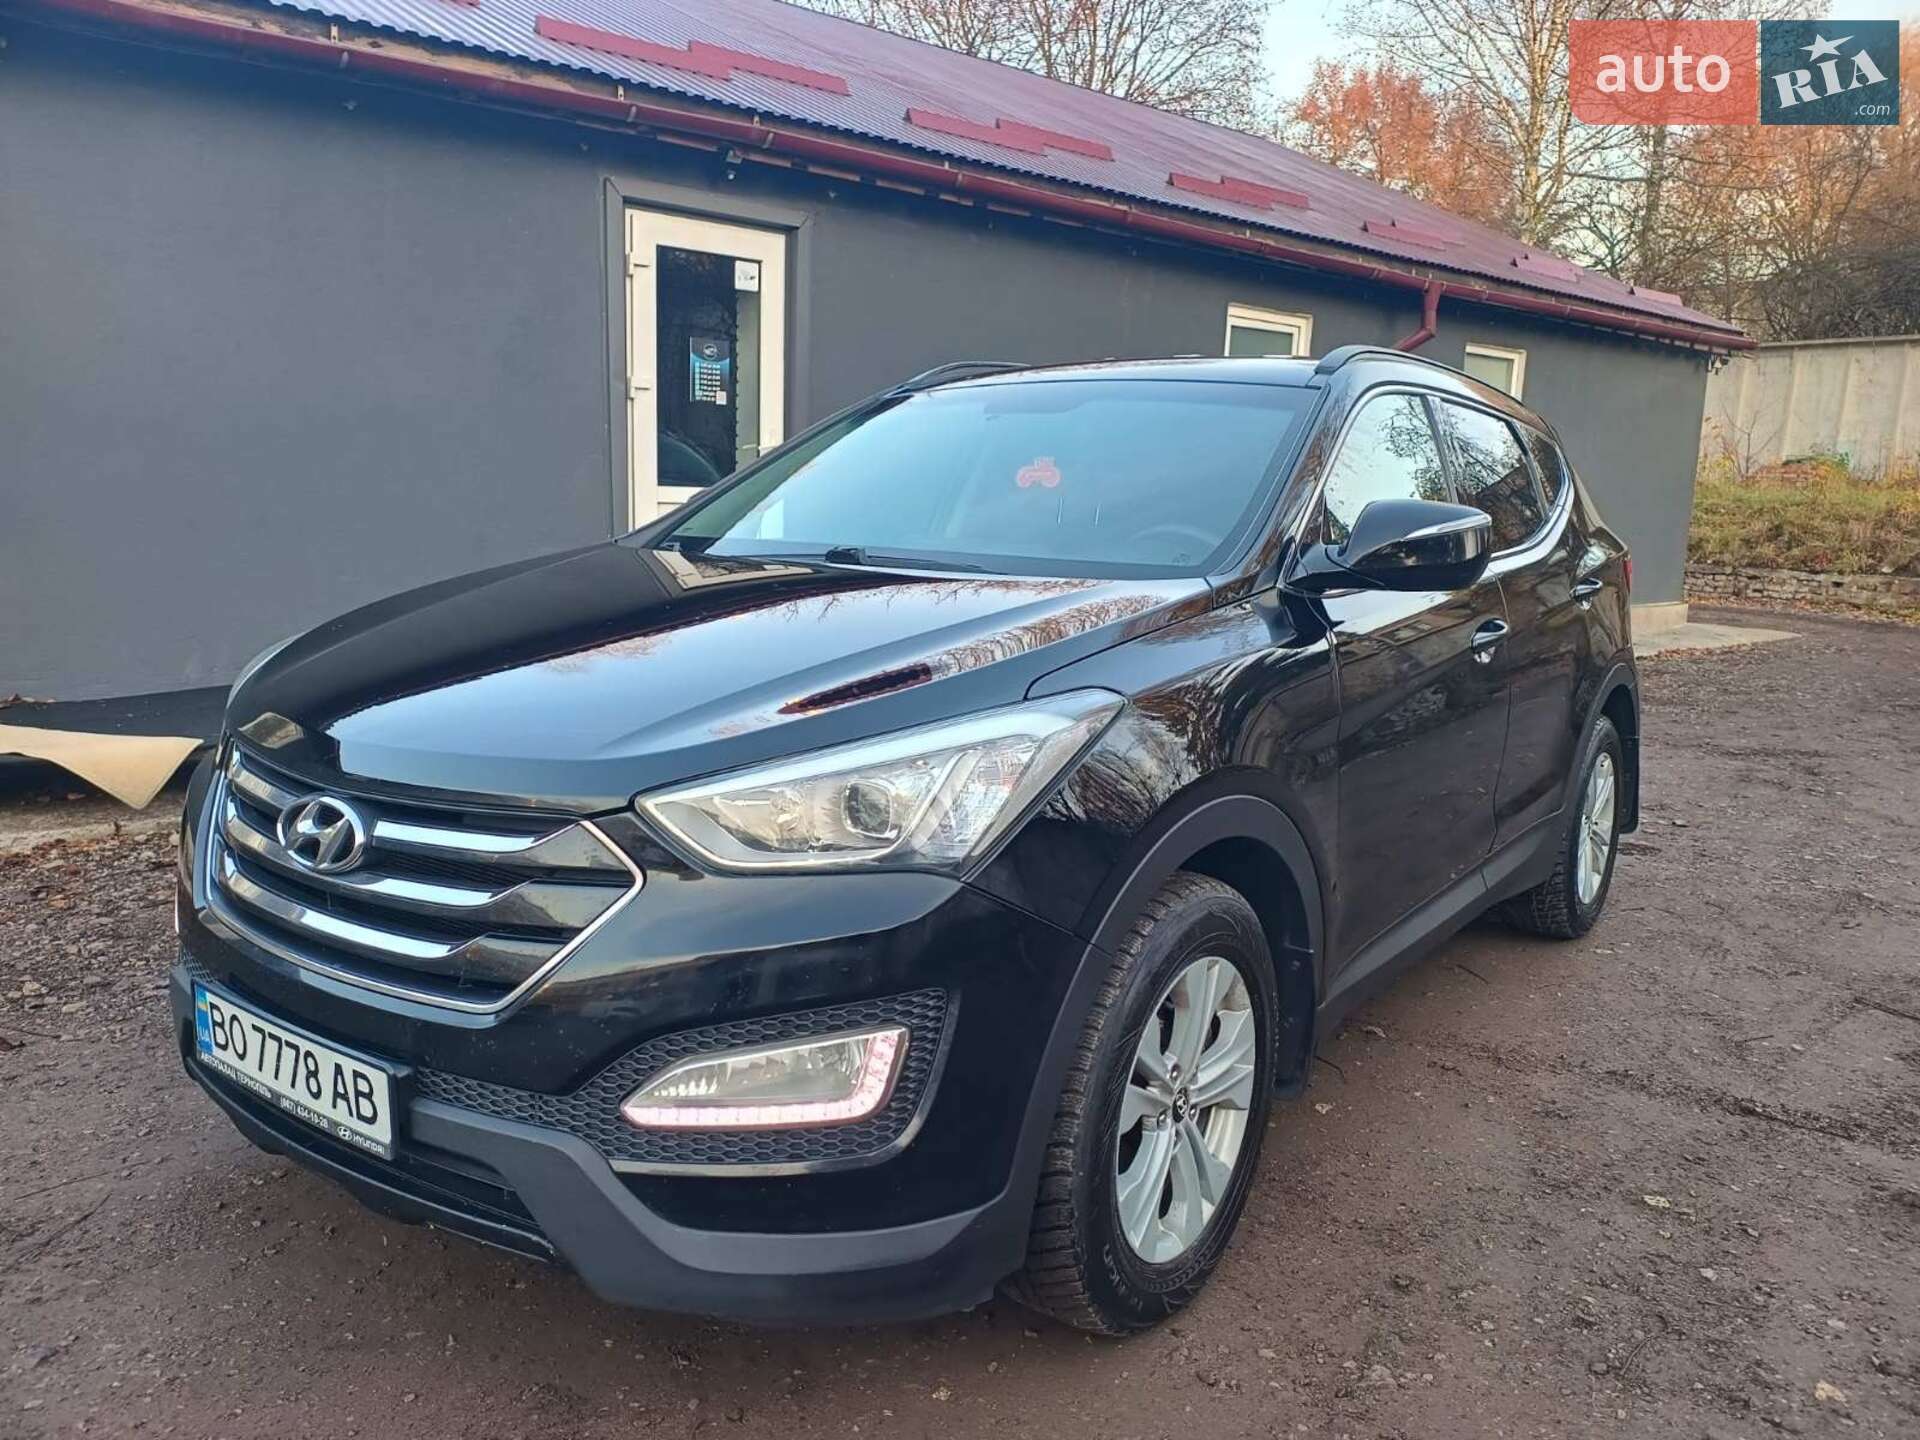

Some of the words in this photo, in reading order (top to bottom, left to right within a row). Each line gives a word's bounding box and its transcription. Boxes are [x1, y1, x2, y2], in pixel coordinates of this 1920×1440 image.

[209, 1001, 248, 1062] BO
[252, 1023, 322, 1100] 7778
[332, 1062, 378, 1126] AB
[352, 1133, 385, 1156] HYUNDAI
